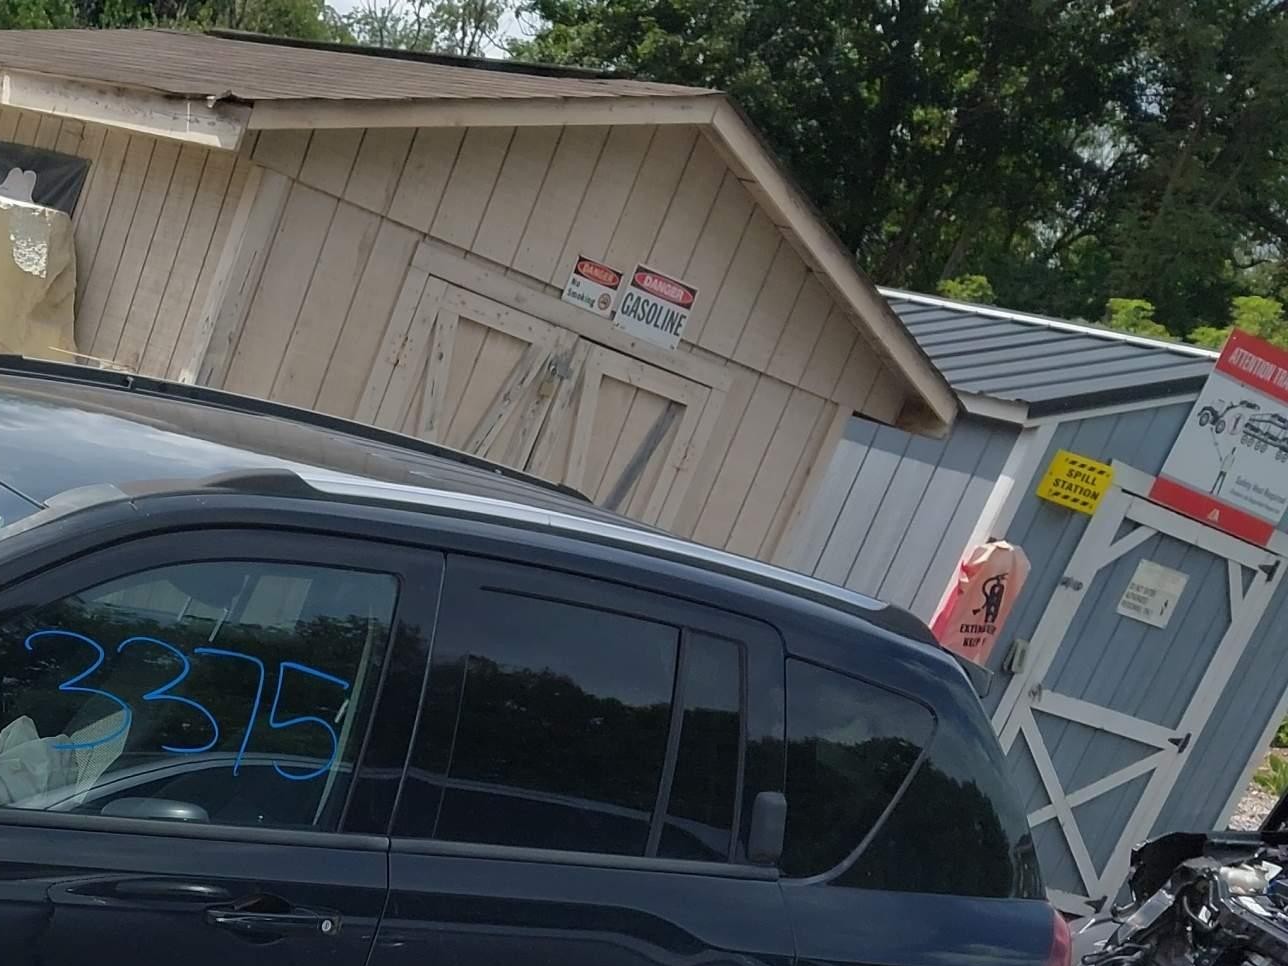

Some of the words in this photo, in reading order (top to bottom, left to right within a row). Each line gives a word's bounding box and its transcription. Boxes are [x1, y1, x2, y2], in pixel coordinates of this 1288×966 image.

[644, 275, 685, 302] DANGER
[621, 292, 688, 337] GASOLINE
[1053, 478, 1100, 500] STATION
[1066, 468, 1097, 486] SPILL
[25, 629, 350, 781] 3375
